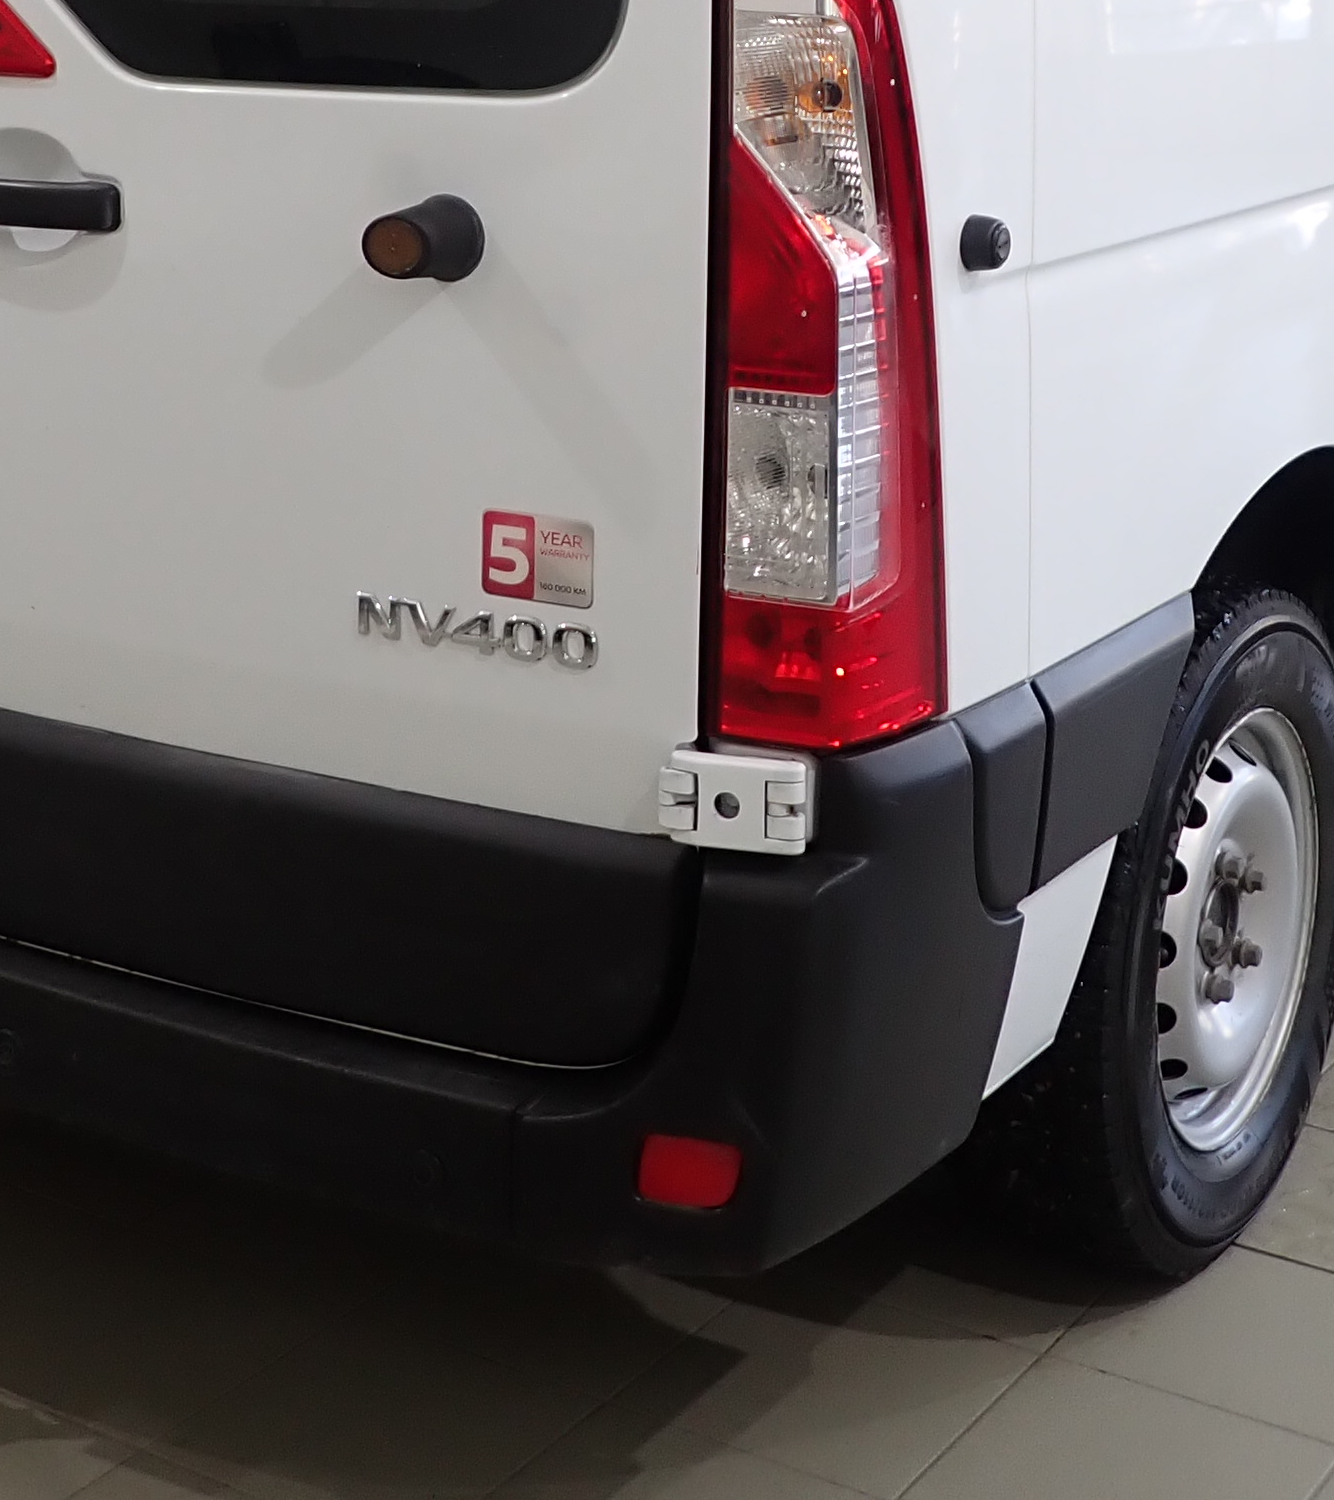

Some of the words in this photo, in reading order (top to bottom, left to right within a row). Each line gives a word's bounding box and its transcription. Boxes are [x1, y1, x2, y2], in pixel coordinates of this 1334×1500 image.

[488, 523, 530, 585] 5
[539, 548, 590, 561] WARRANTY
[540, 530, 583, 549] YEAR
[356, 590, 599, 670] NV400
